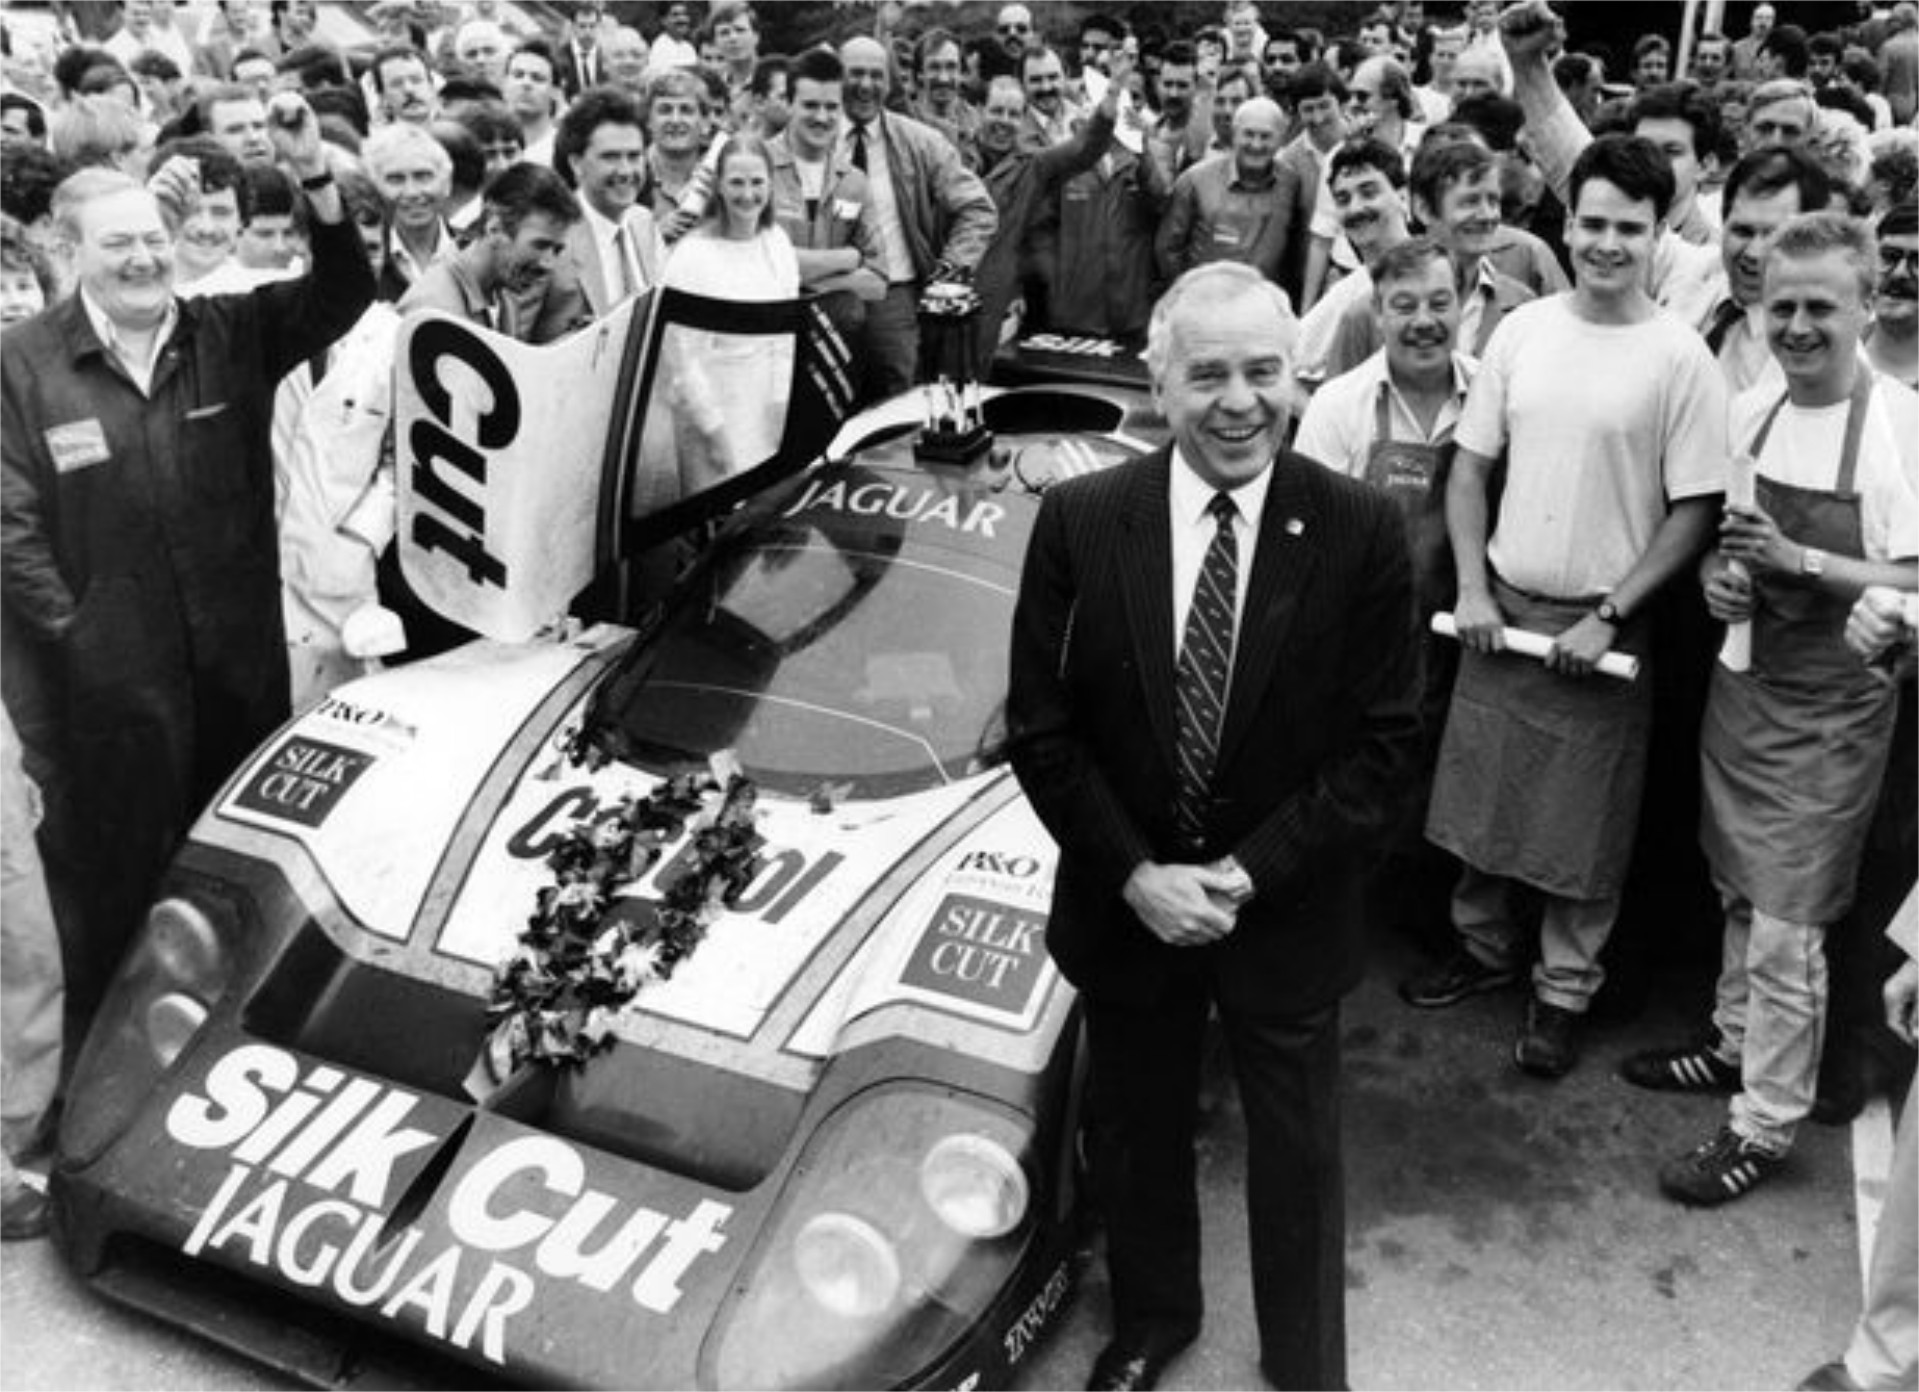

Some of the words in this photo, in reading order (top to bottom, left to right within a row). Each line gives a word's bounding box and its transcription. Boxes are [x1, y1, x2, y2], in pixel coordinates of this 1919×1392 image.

[408, 319, 522, 590] Cut
[783, 479, 1006, 538] JAGUAR
[260, 771, 330, 810] CUT
[275, 745, 357, 784] SILK
[938, 905, 1044, 955] SILK
[931, 941, 1021, 988] CUT
[166, 1044, 439, 1208] Silk
[448, 1134, 734, 1313] Cut
[182, 1166, 535, 1364] JAGUAR
